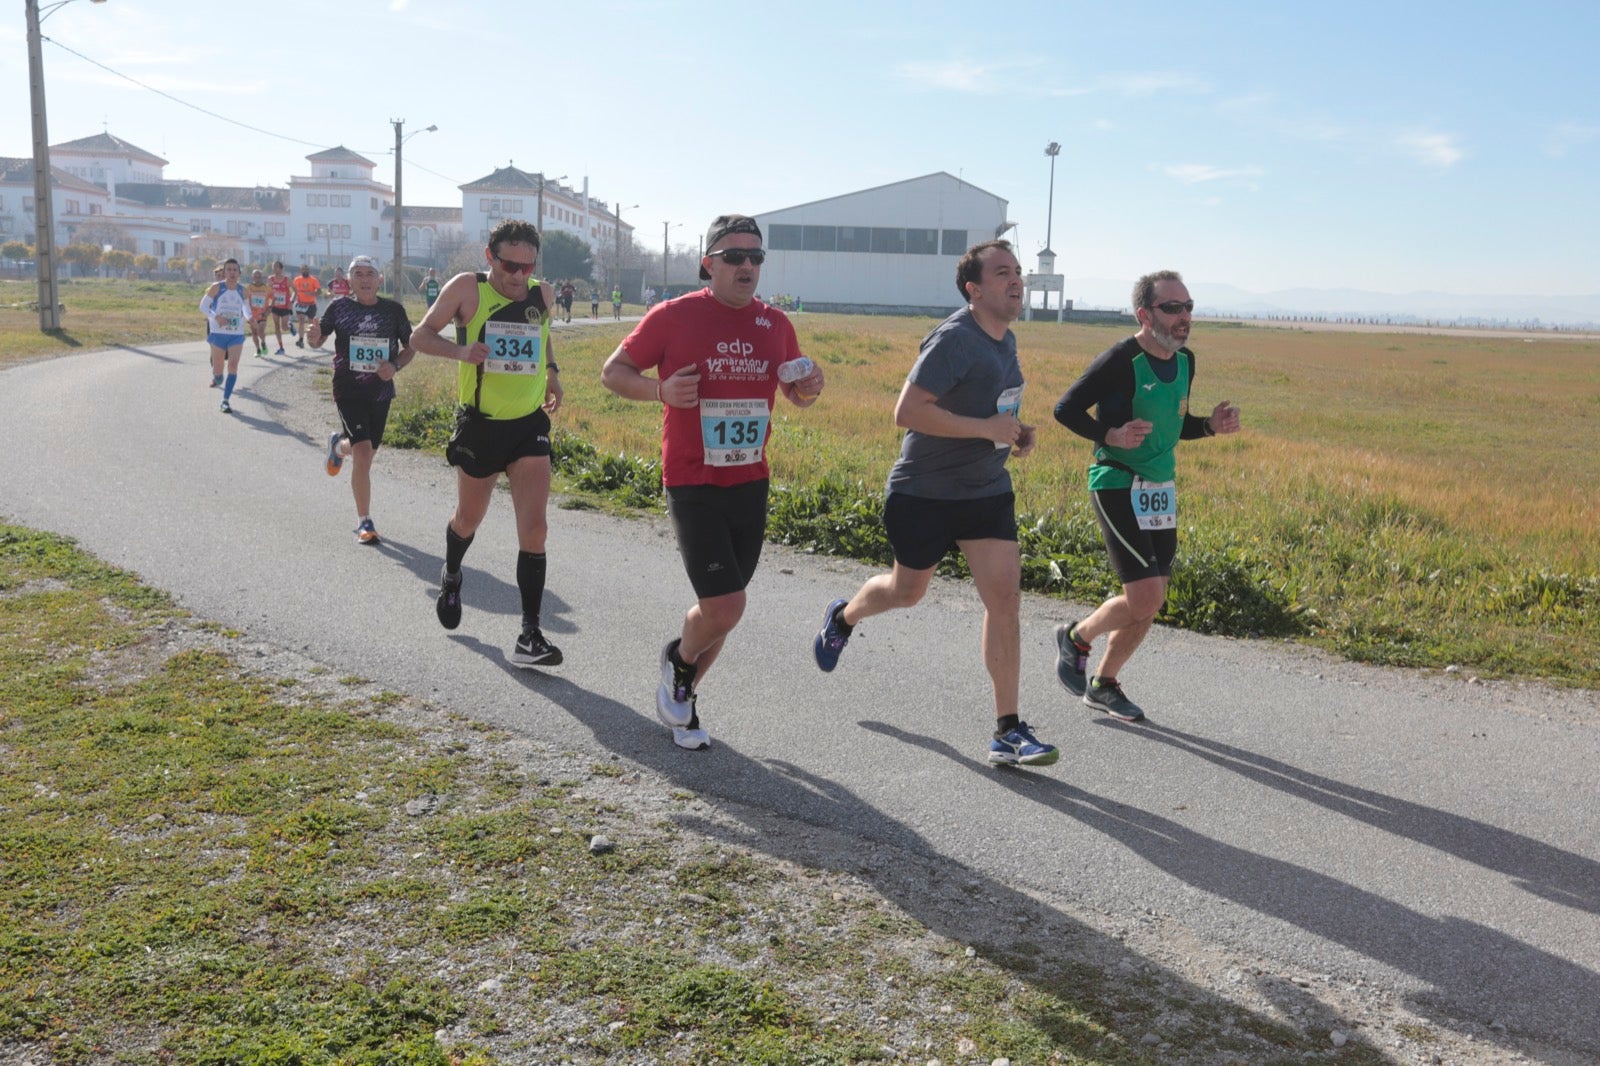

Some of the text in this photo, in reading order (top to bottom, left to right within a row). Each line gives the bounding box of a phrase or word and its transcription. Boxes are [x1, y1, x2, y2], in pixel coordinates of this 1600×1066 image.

[356, 348, 383, 361] 839
[495, 338, 534, 358] 334
[716, 338, 754, 357] edp
[713, 420, 759, 445] 135
[1139, 491, 1169, 513] 969
